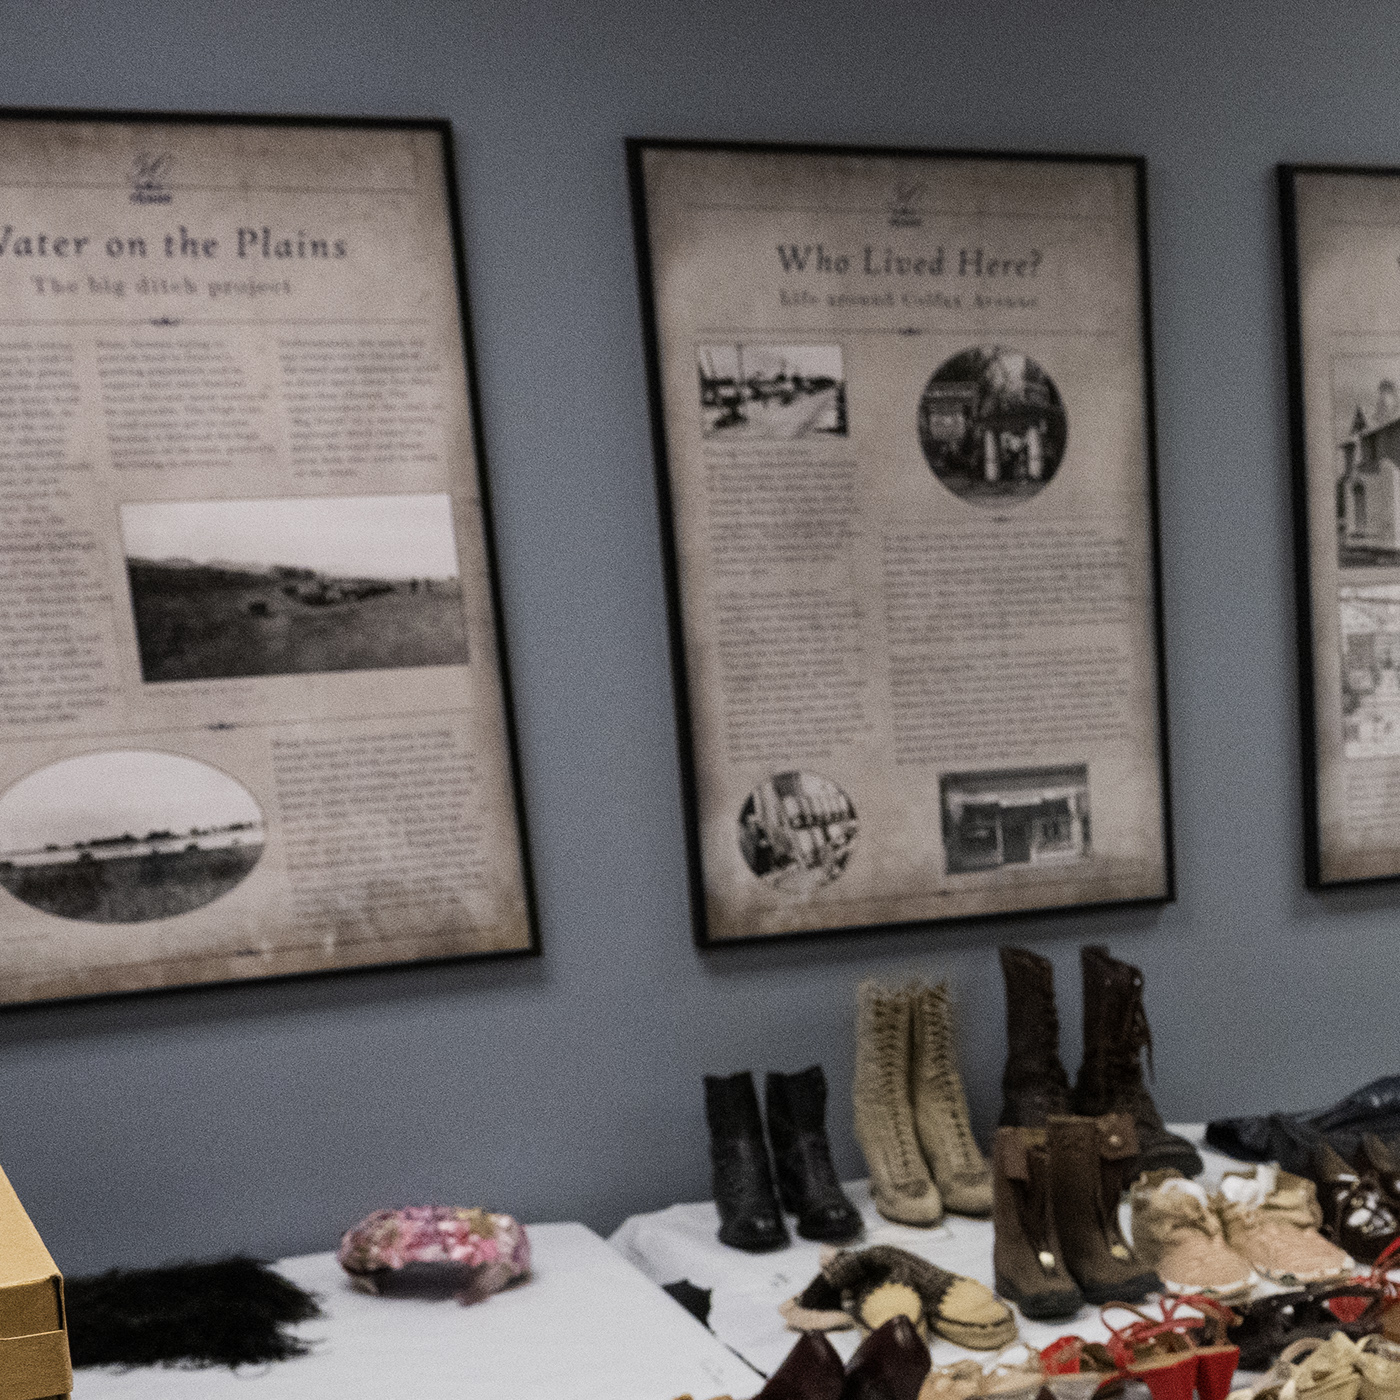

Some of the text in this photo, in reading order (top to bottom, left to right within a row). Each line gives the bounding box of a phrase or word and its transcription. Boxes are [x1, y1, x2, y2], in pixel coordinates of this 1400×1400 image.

[105, 237, 147, 258] on
[164, 225, 218, 259] the
[236, 226, 348, 260] Plains
[776, 244, 1043, 279] Who Lived Here?
[32, 275, 293, 300] The big ditch project
